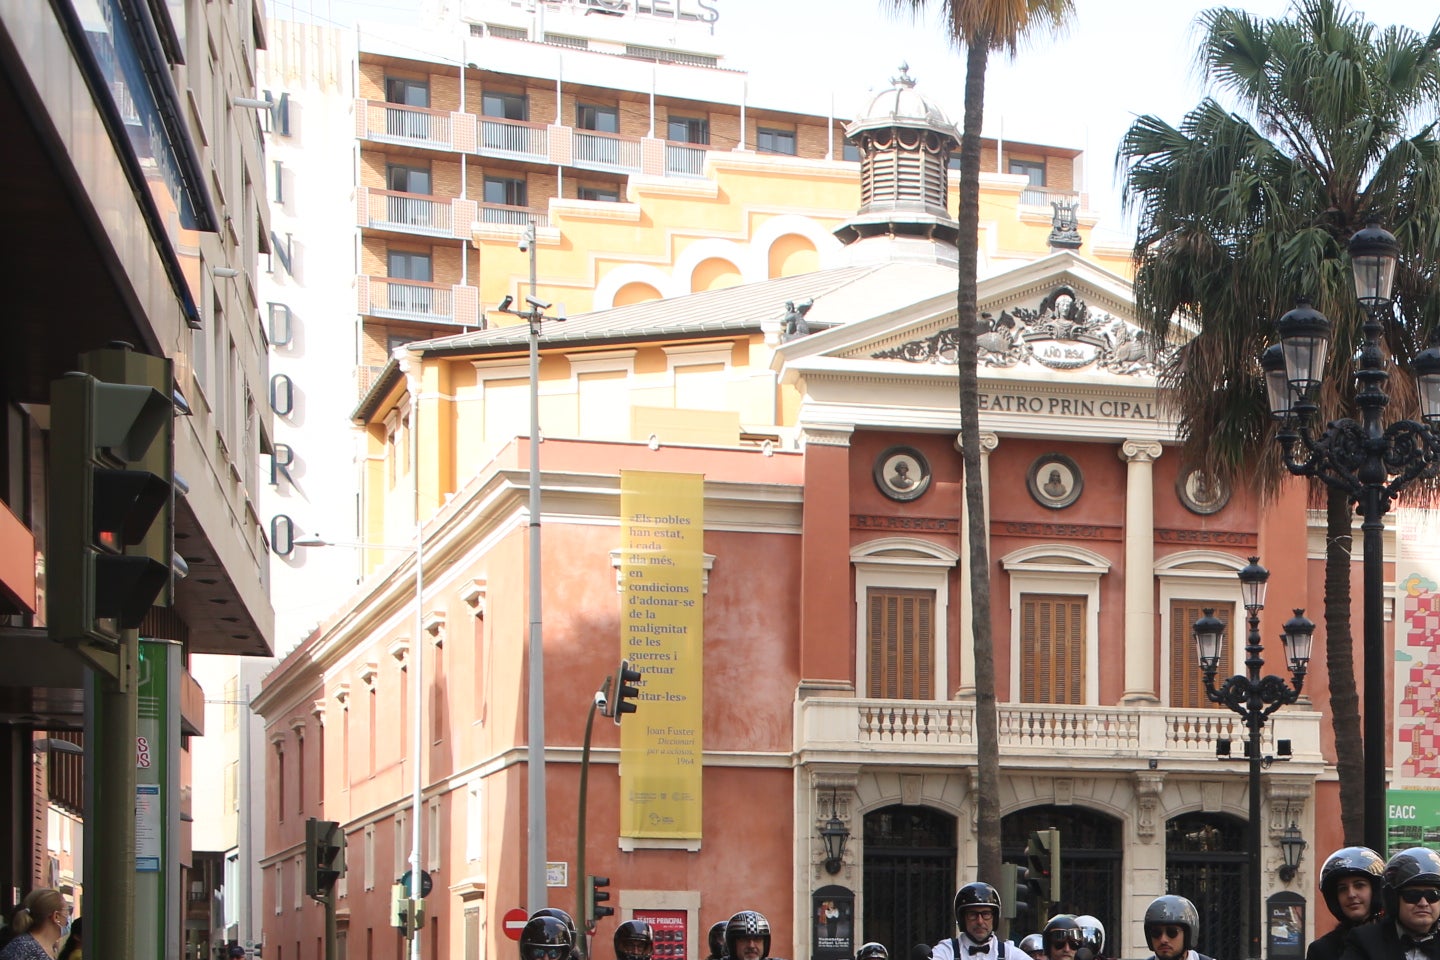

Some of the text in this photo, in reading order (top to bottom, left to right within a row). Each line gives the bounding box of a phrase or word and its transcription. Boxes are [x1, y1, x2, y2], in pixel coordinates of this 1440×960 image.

[262, 89, 294, 557] MINDORO
[978, 394, 1044, 412] EATRO
[655, 514, 691, 525] pobles
[629, 526, 684, 540] han estat,
[635, 541, 662, 551] cada
[629, 554, 675, 567] dia més,
[629, 569, 643, 578] en
[629, 582, 690, 593] condicions
[629, 596, 695, 607] d'adonar-se
[629, 609, 656, 619] de la
[629, 623, 688, 635] malignitat
[629, 636, 661, 647] de les
[629, 651, 671, 661] guerres
[629, 664, 675, 675] d'actuar
[629, 681, 647, 690] per
[647, 726, 695, 736] Joan Fuster
[1388, 804, 1416, 819] EACC
